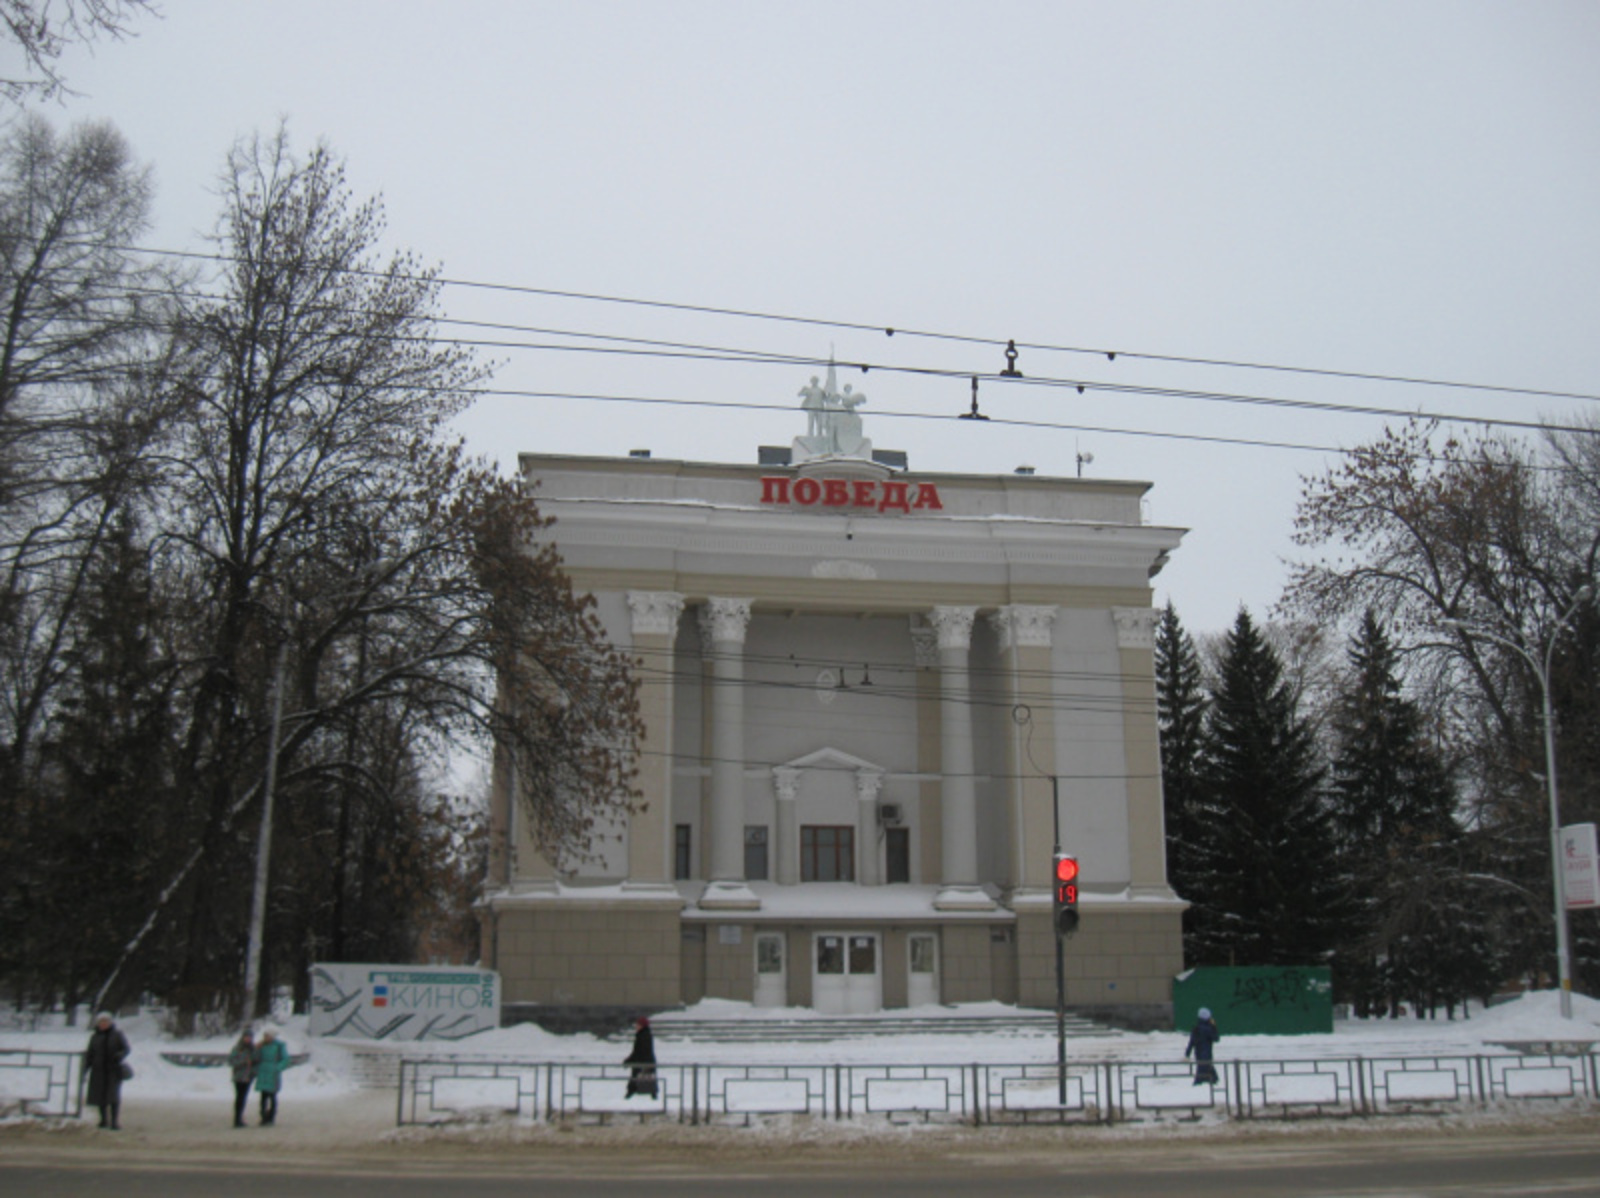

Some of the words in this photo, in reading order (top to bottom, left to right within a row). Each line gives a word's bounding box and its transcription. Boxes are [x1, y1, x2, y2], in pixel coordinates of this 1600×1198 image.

[760, 476, 943, 513] ПОБЕДА
[1058, 884, 1077, 904] 19
[390, 986, 481, 1009] КИНО
